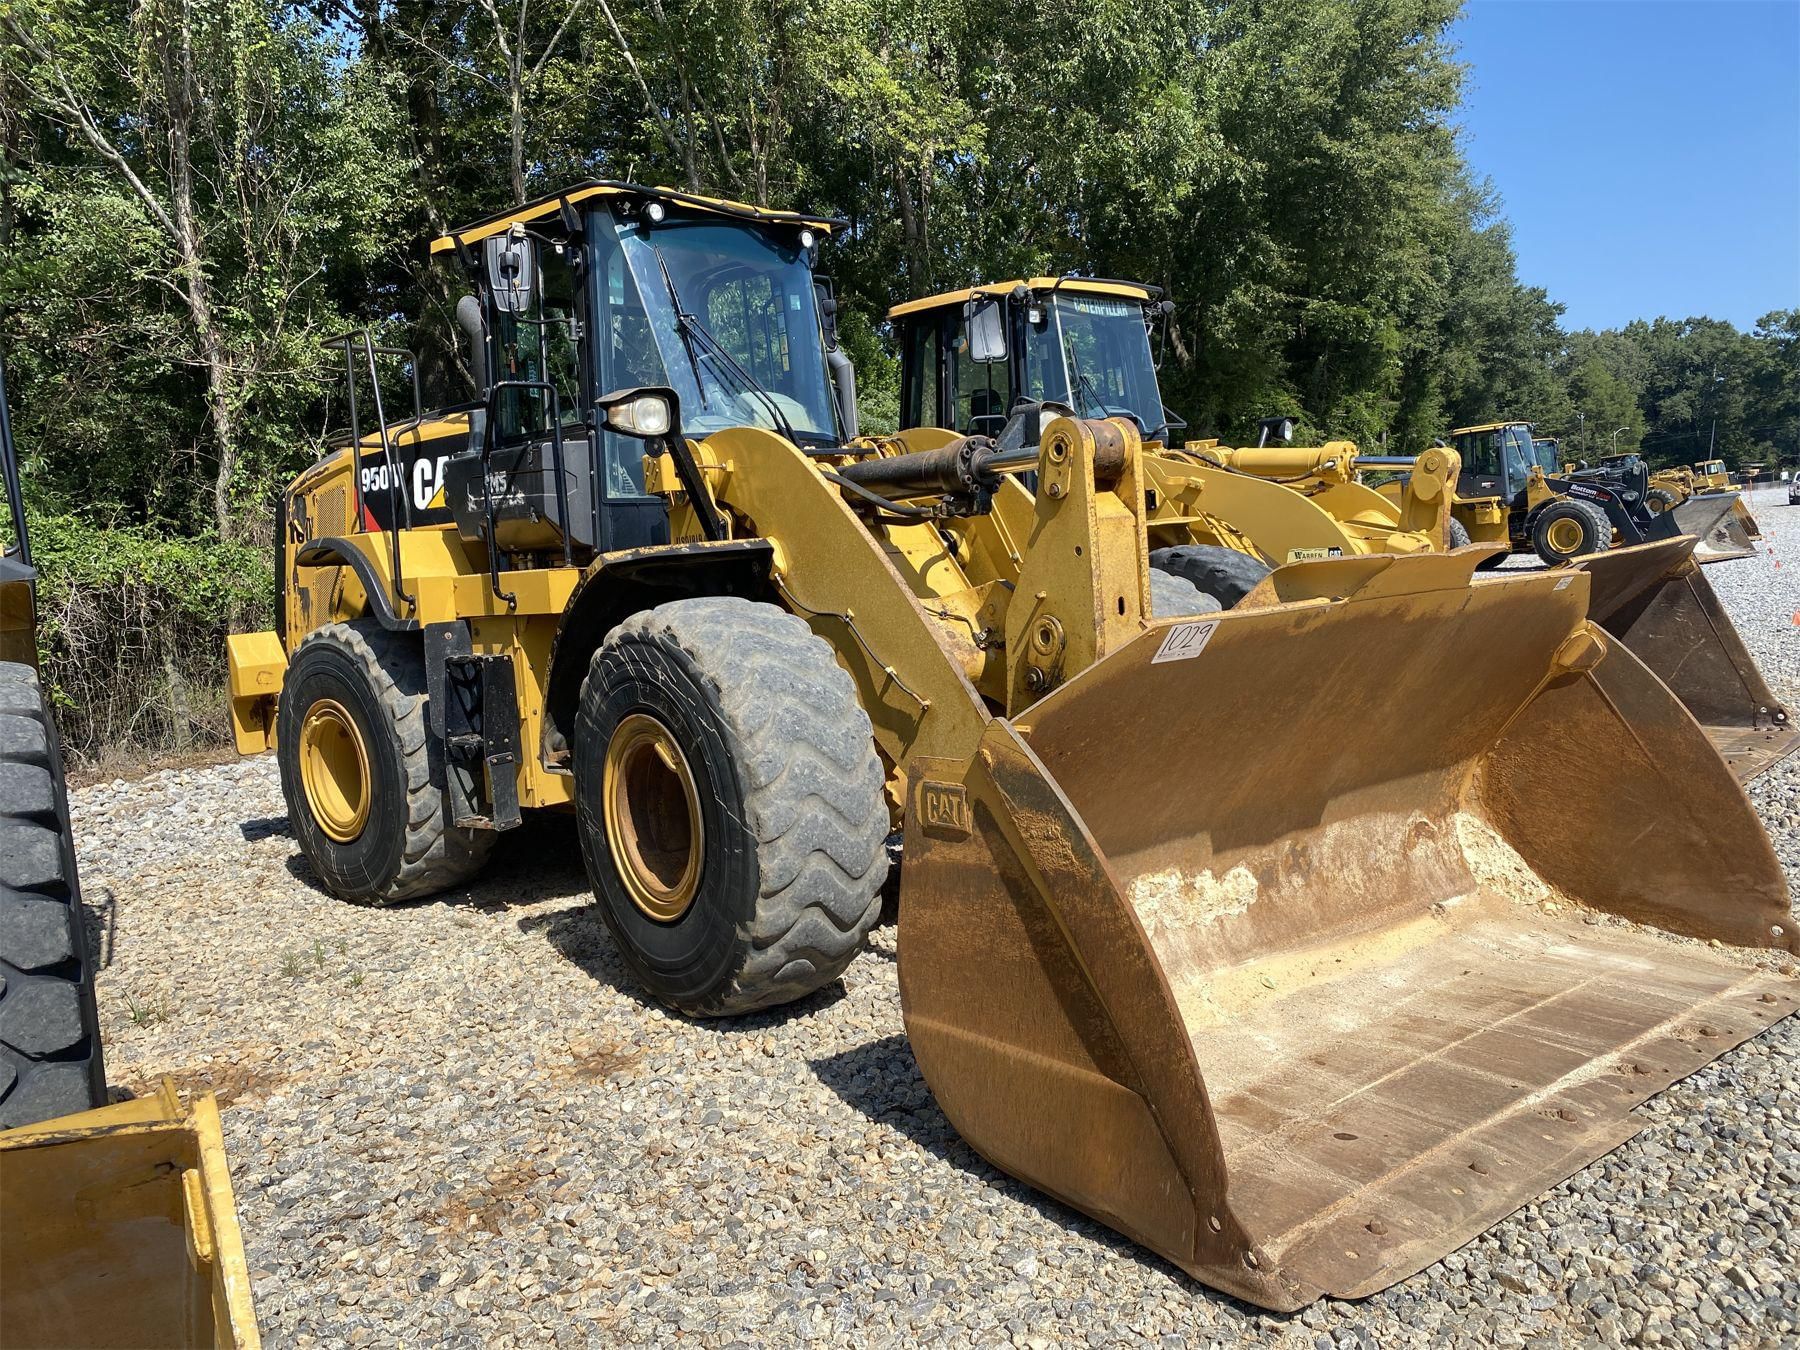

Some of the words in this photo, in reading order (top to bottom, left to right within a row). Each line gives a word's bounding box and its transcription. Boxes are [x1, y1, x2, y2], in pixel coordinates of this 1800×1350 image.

[413, 455, 450, 510] CA
[1161, 623, 1214, 654] 1029
[926, 791, 962, 828] CAT
